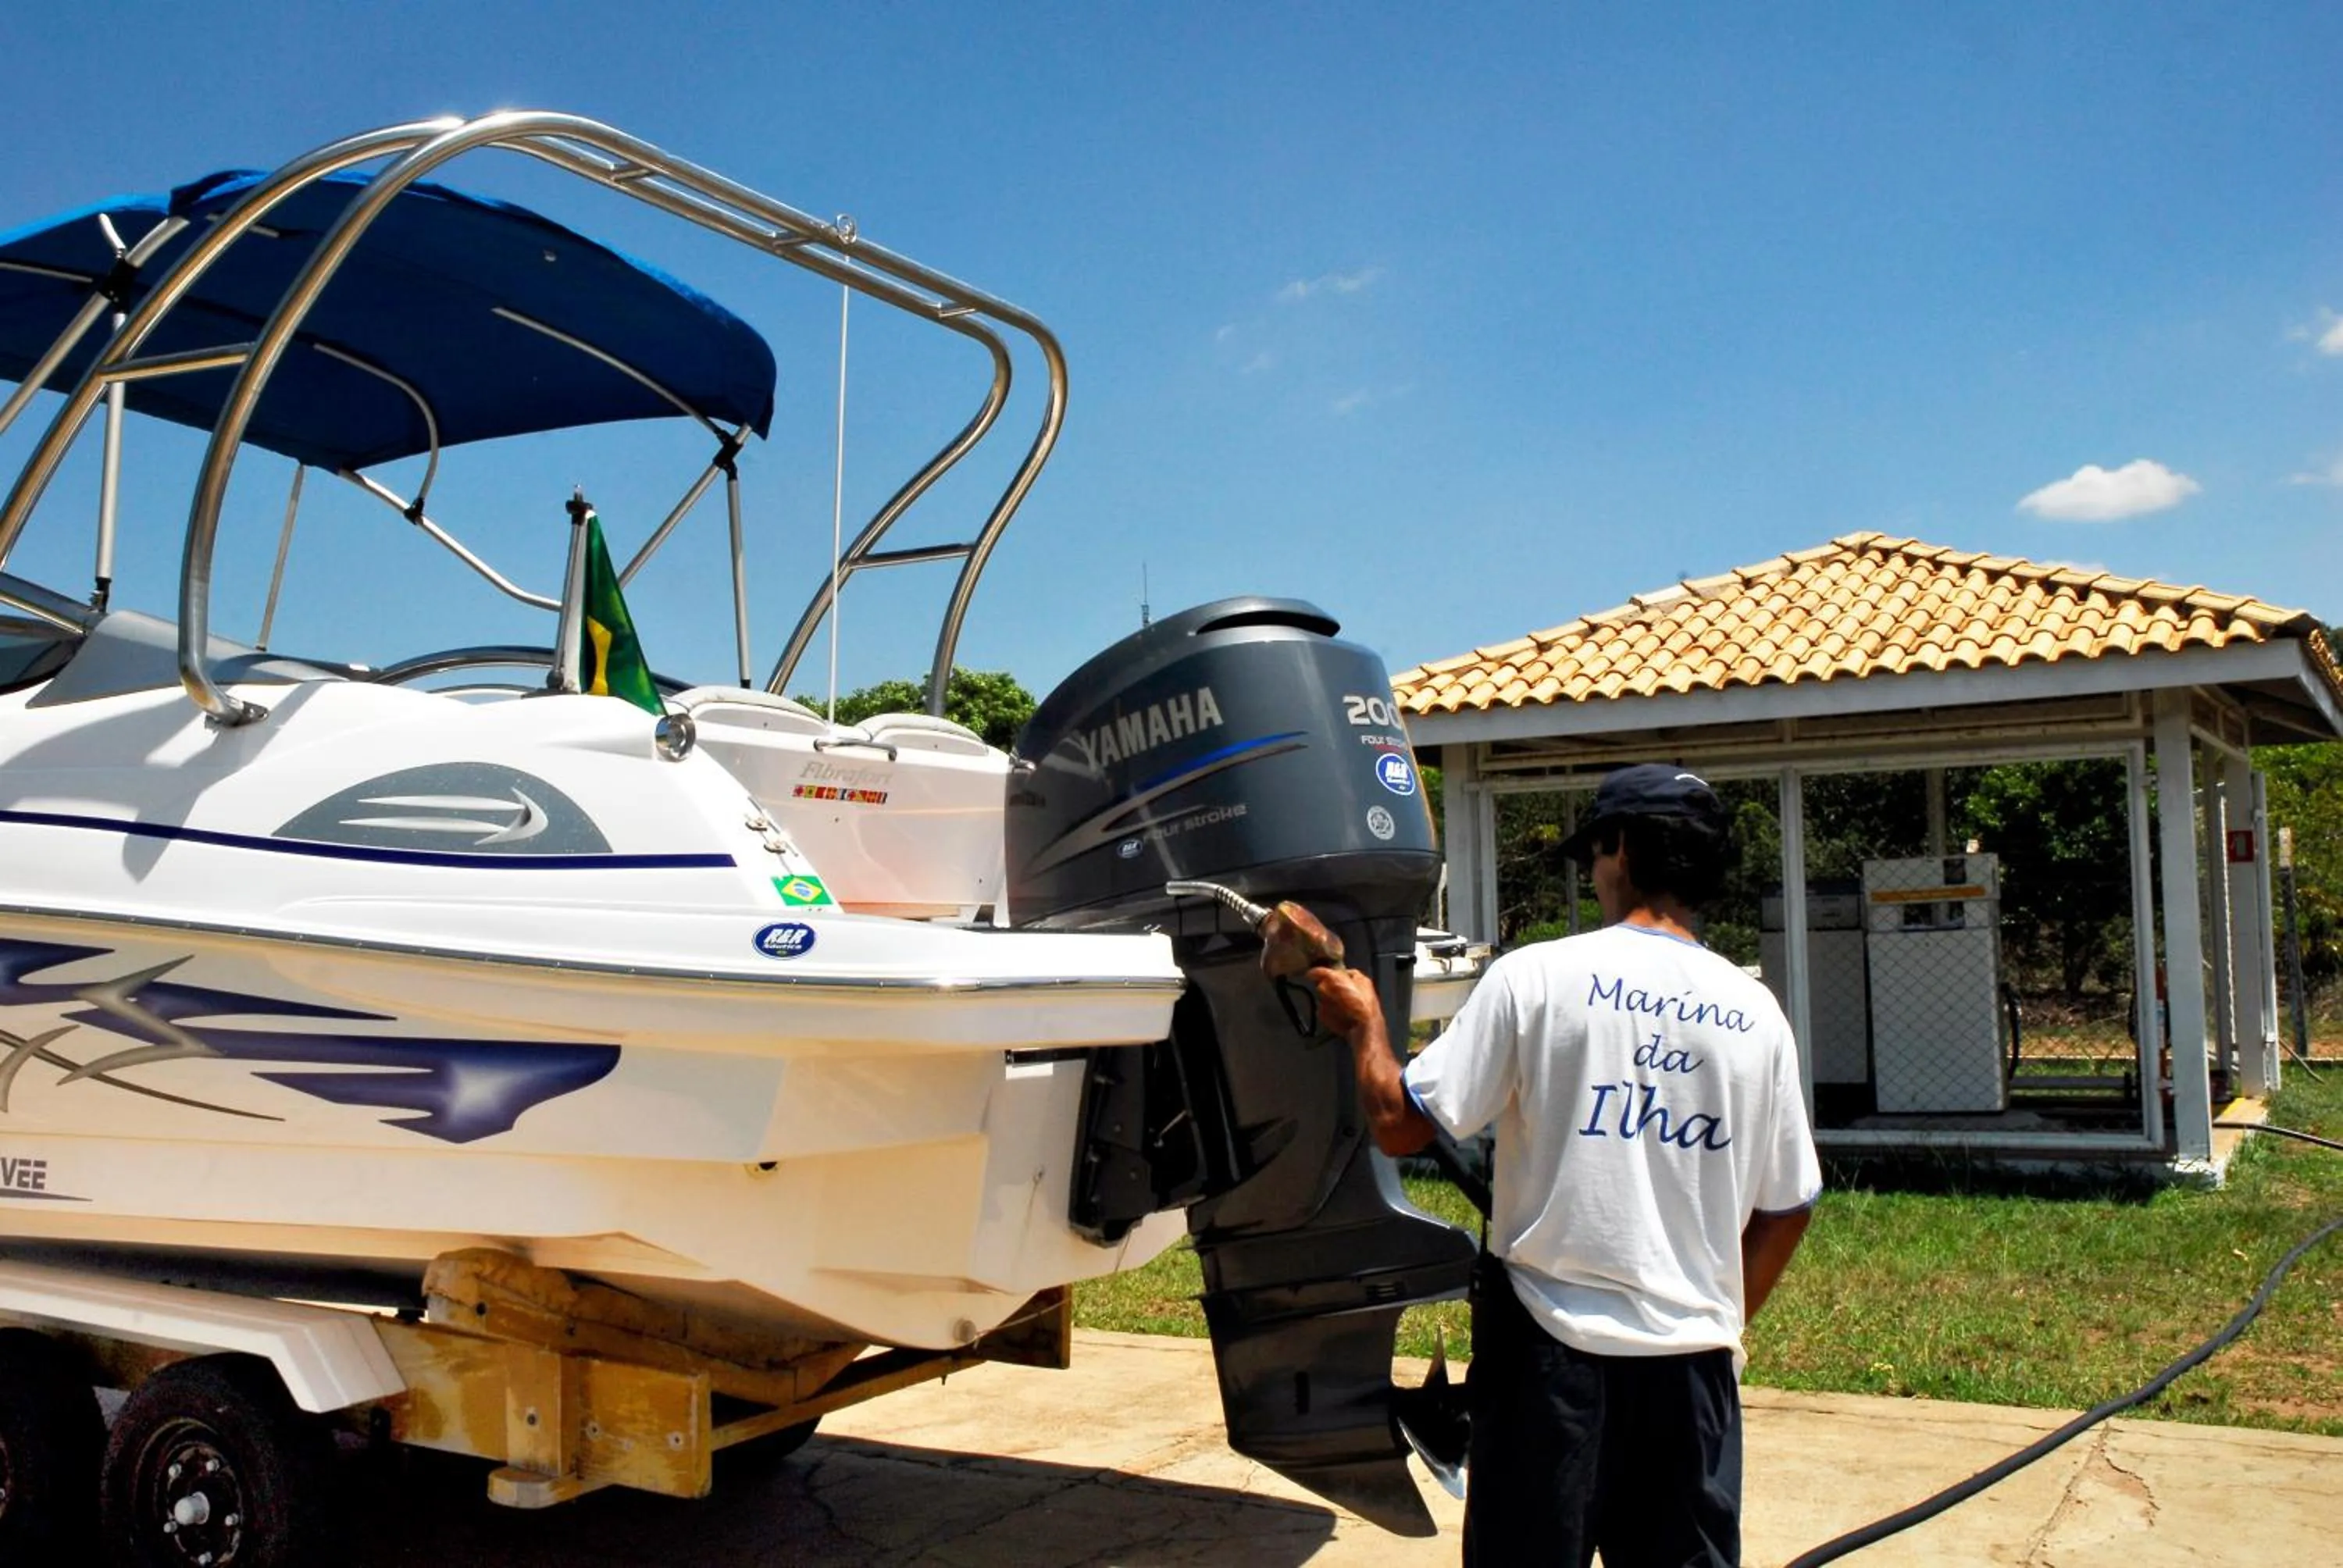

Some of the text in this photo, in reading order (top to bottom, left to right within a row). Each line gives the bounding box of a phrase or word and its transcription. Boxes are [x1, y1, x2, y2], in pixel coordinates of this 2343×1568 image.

[1079, 686, 1224, 772] YAMAHA
[1588, 973, 1756, 1033] Marina
[1633, 1034, 1704, 1074] da
[1578, 1081, 1732, 1151] Ilha
